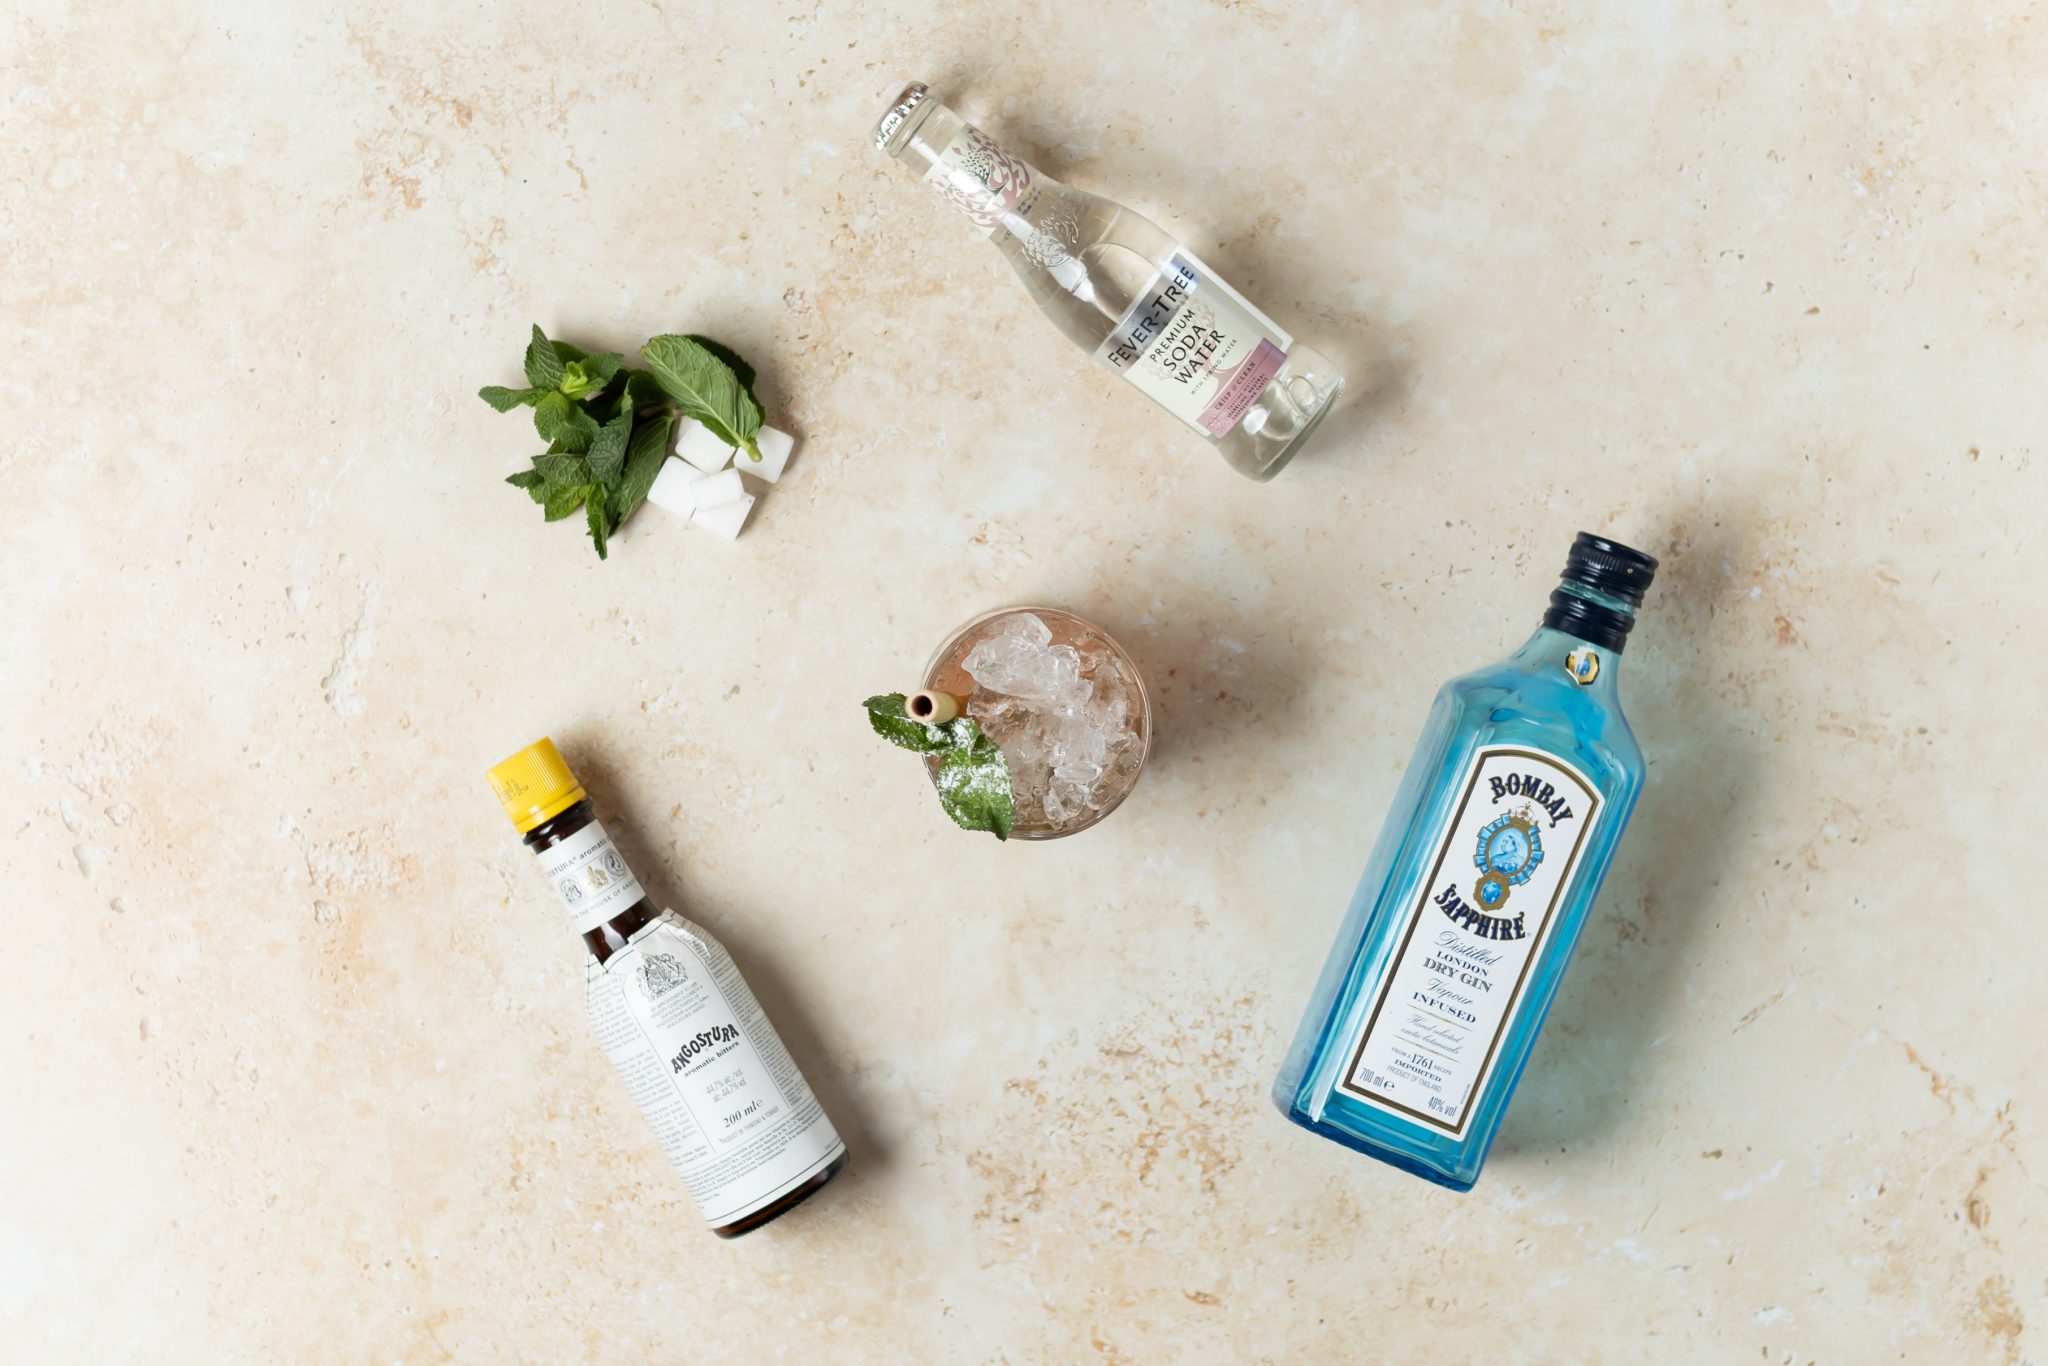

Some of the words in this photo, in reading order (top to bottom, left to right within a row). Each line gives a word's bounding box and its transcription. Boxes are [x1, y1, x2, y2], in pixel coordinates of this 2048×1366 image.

[1107, 266, 1195, 366] FEVER-TREE
[1149, 309, 1196, 363] PREMIUM
[1162, 322, 1207, 372] SODA
[1174, 328, 1226, 387] WATER
[1190, 381, 1204, 396] WITH
[1202, 359, 1222, 382] SPRING
[1220, 339, 1238, 359] WATER
[1214, 391, 1233, 412] CRISP
[1235, 361, 1256, 385] CLEAN
[1488, 772, 1573, 828] BOMBAY
[577, 837, 608, 860] aromatic
[1434, 883, 1526, 941] SAPPHIRE
[1433, 927, 1504, 971] Distilled
[1436, 950, 1489, 978] LONDON
[1423, 956, 1459, 980] DRY
[1458, 971, 1493, 994] GIN
[1424, 975, 1476, 1011] Vapour
[1412, 990, 1477, 1026] INFUSED
[671, 1023, 740, 1075] ANGOSTURA
[683, 1055, 716, 1079] aromatic
[715, 1039, 740, 1058] bitters
[1411, 1052, 1434, 1070] 1761
[1359, 1067, 1375, 1084] 700
[1372, 1073, 1385, 1088] ml
[1386, 1064, 1411, 1080] PRODUCT
[1418, 1077, 1442, 1093] ENGLAND
[1394, 1058, 1442, 1084] IMPORTED
[721, 1110, 743, 1129] 200
[740, 1100, 758, 1117] ml
[1426, 1095, 1446, 1113] 40%
[1443, 1102, 1458, 1118] vol
